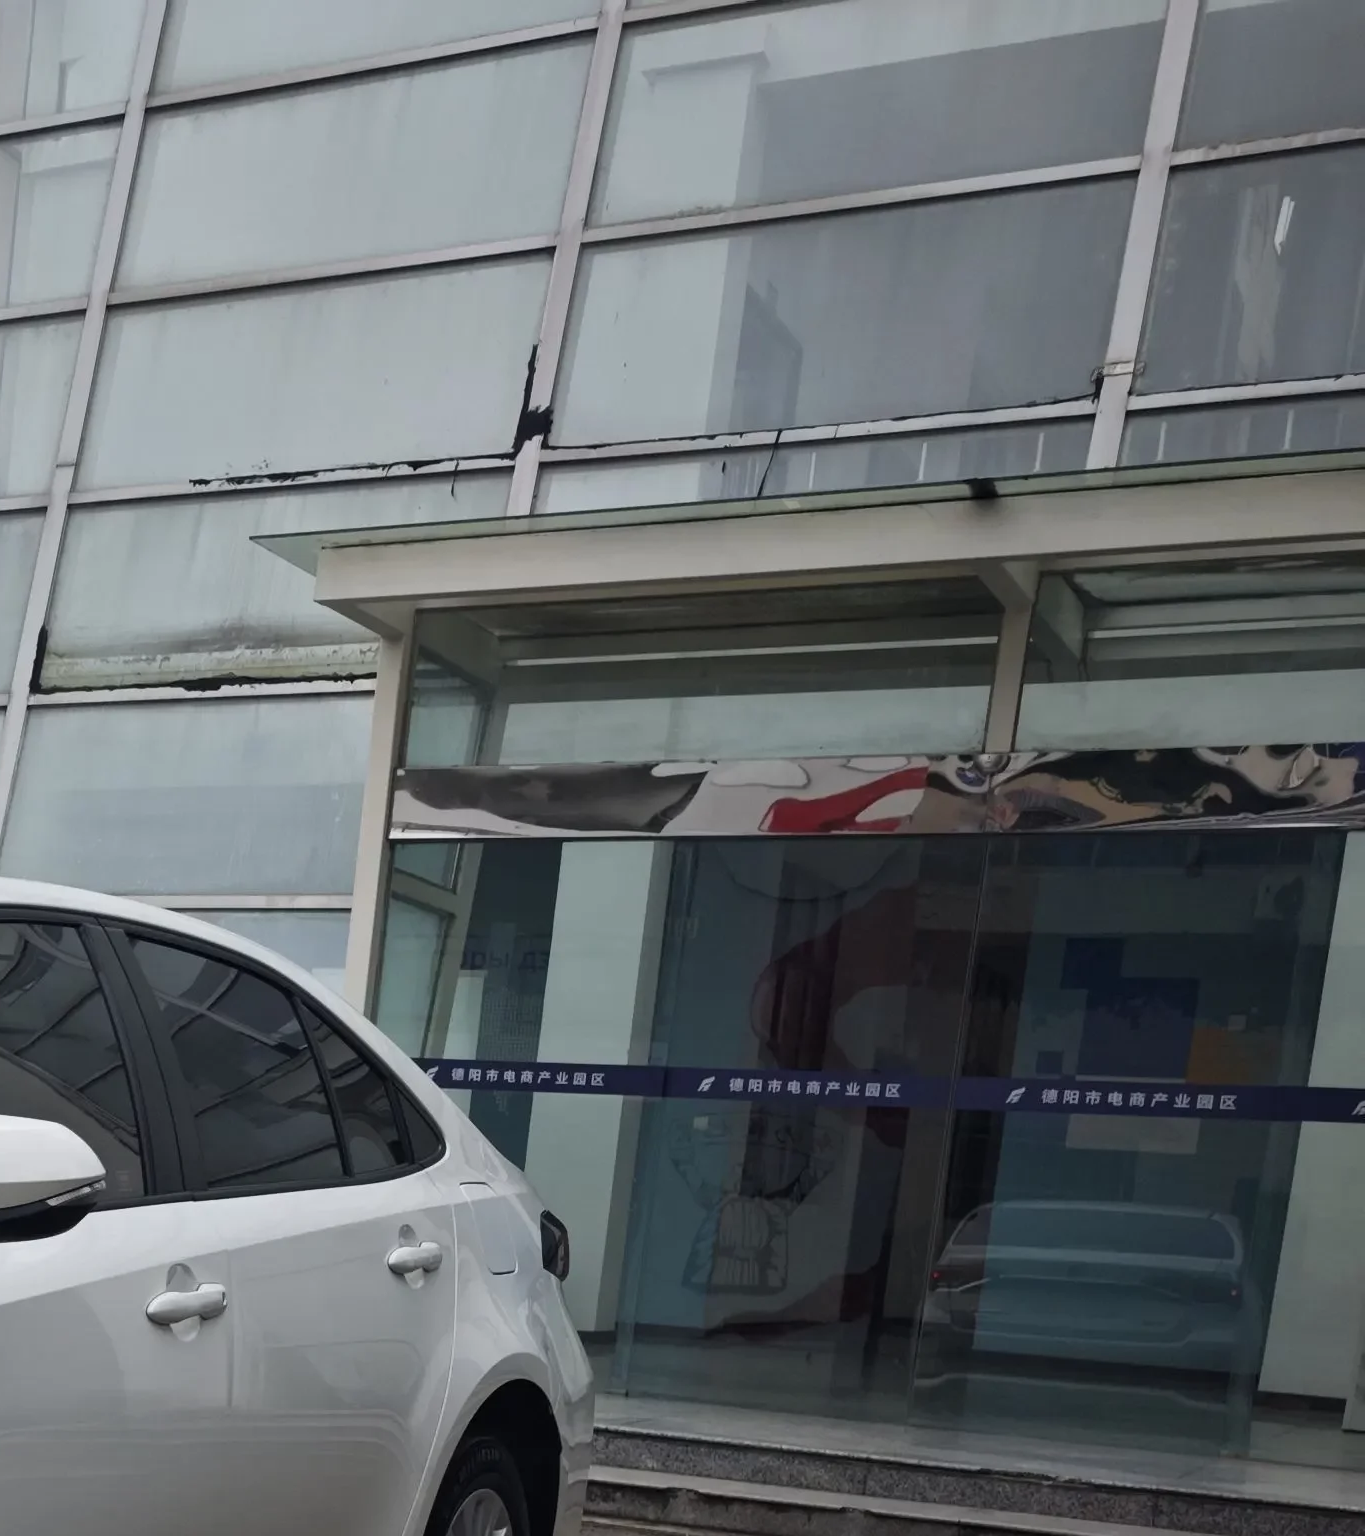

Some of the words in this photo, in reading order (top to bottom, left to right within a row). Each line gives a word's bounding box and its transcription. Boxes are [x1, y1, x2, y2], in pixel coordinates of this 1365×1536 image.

[451, 1068, 605, 1087] 德阳市电商产业园区
[729, 1078, 901, 1098] 德阳市电商产业园区
[1041, 1089, 1238, 1110] 德阳市电商产业园区
